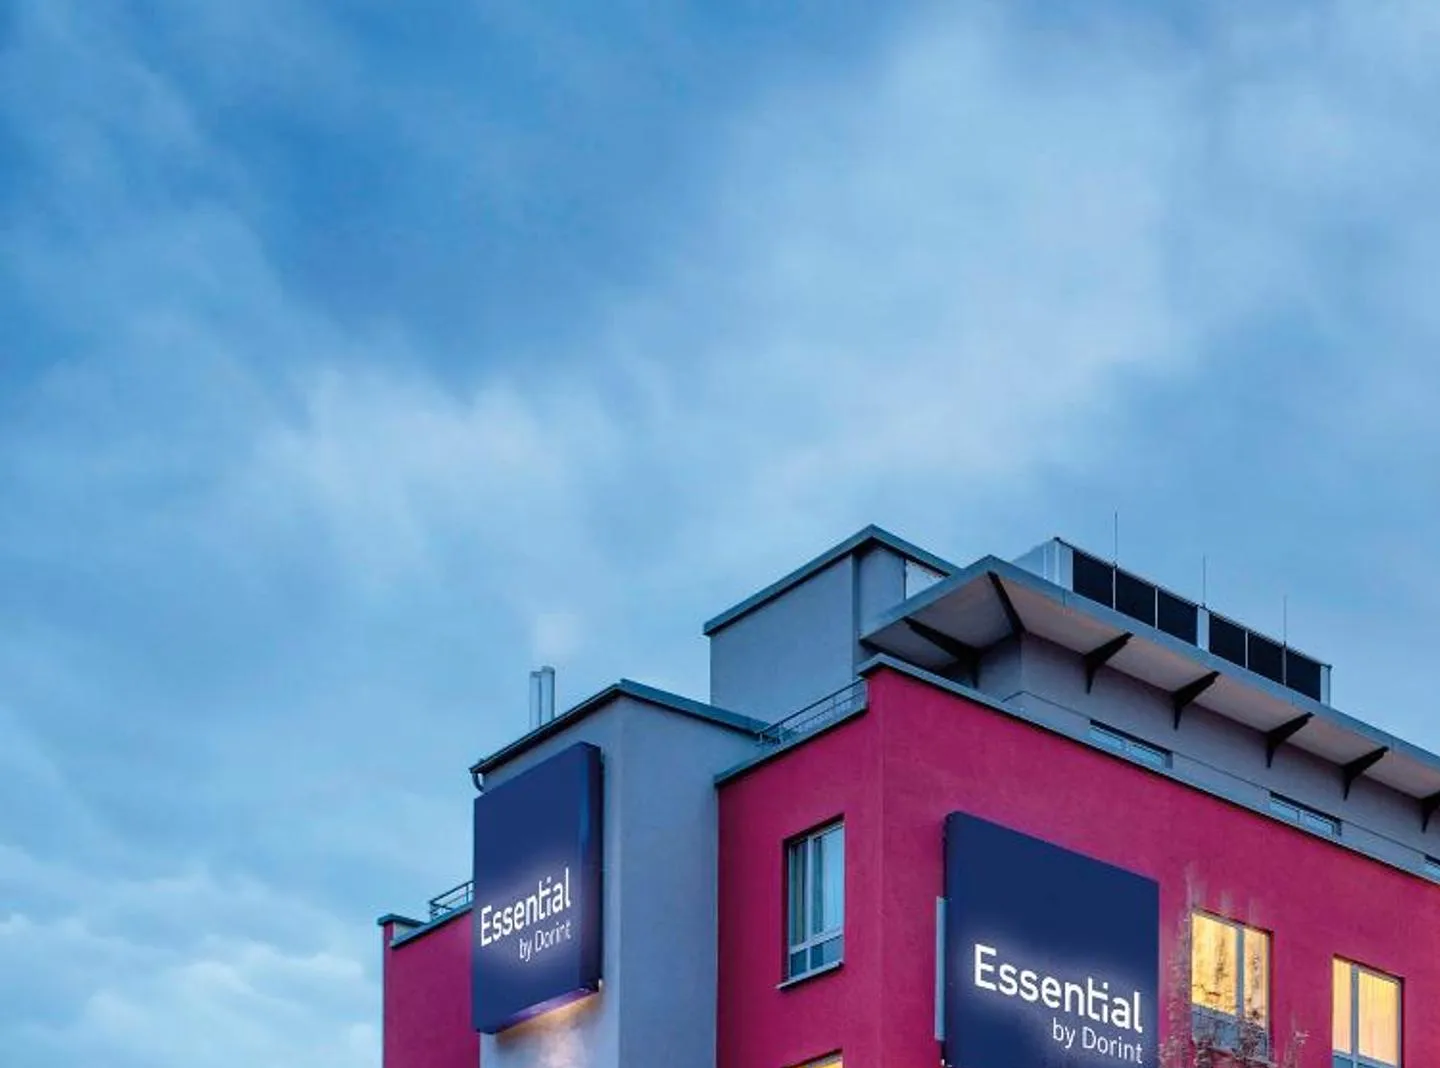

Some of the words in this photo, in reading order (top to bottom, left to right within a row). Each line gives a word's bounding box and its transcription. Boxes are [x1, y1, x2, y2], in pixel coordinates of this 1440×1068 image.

[481, 867, 571, 947] Essential
[519, 938, 532, 962] by
[535, 920, 571, 952] Dorint
[974, 943, 1143, 1033] Essential
[1052, 1017, 1076, 1049] by
[1081, 1026, 1143, 1064] Dorint
